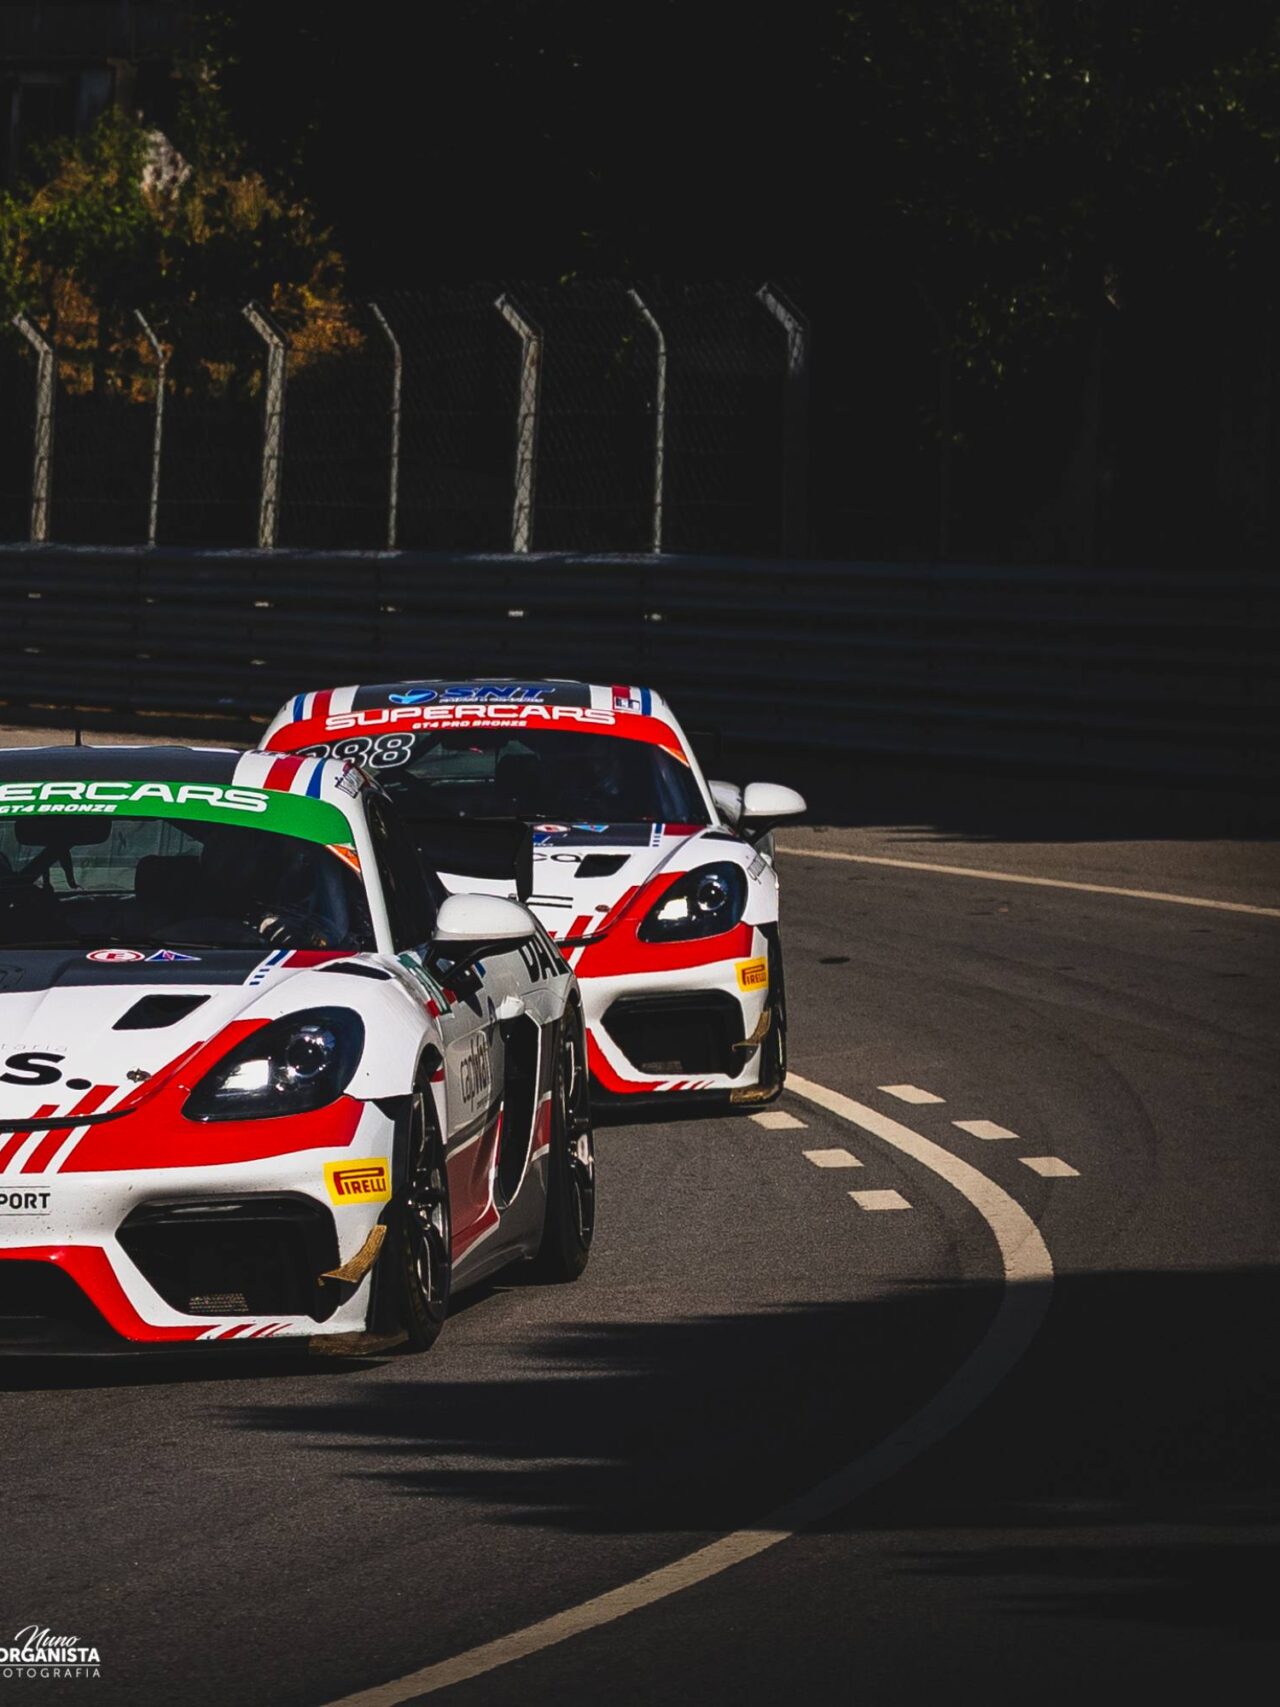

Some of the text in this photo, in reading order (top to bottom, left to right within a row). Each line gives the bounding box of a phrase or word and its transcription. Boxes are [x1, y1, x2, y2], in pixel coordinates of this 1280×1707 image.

[441, 686, 556, 700] SNT
[325, 704, 615, 731] SUPERCARS
[412, 720, 527, 730] GT4 PRO BRONZE
[37, 803, 118, 813] BRONZE
[741, 964, 767, 986] PIRELLI
[333, 1166, 387, 1196] PIRELLI
